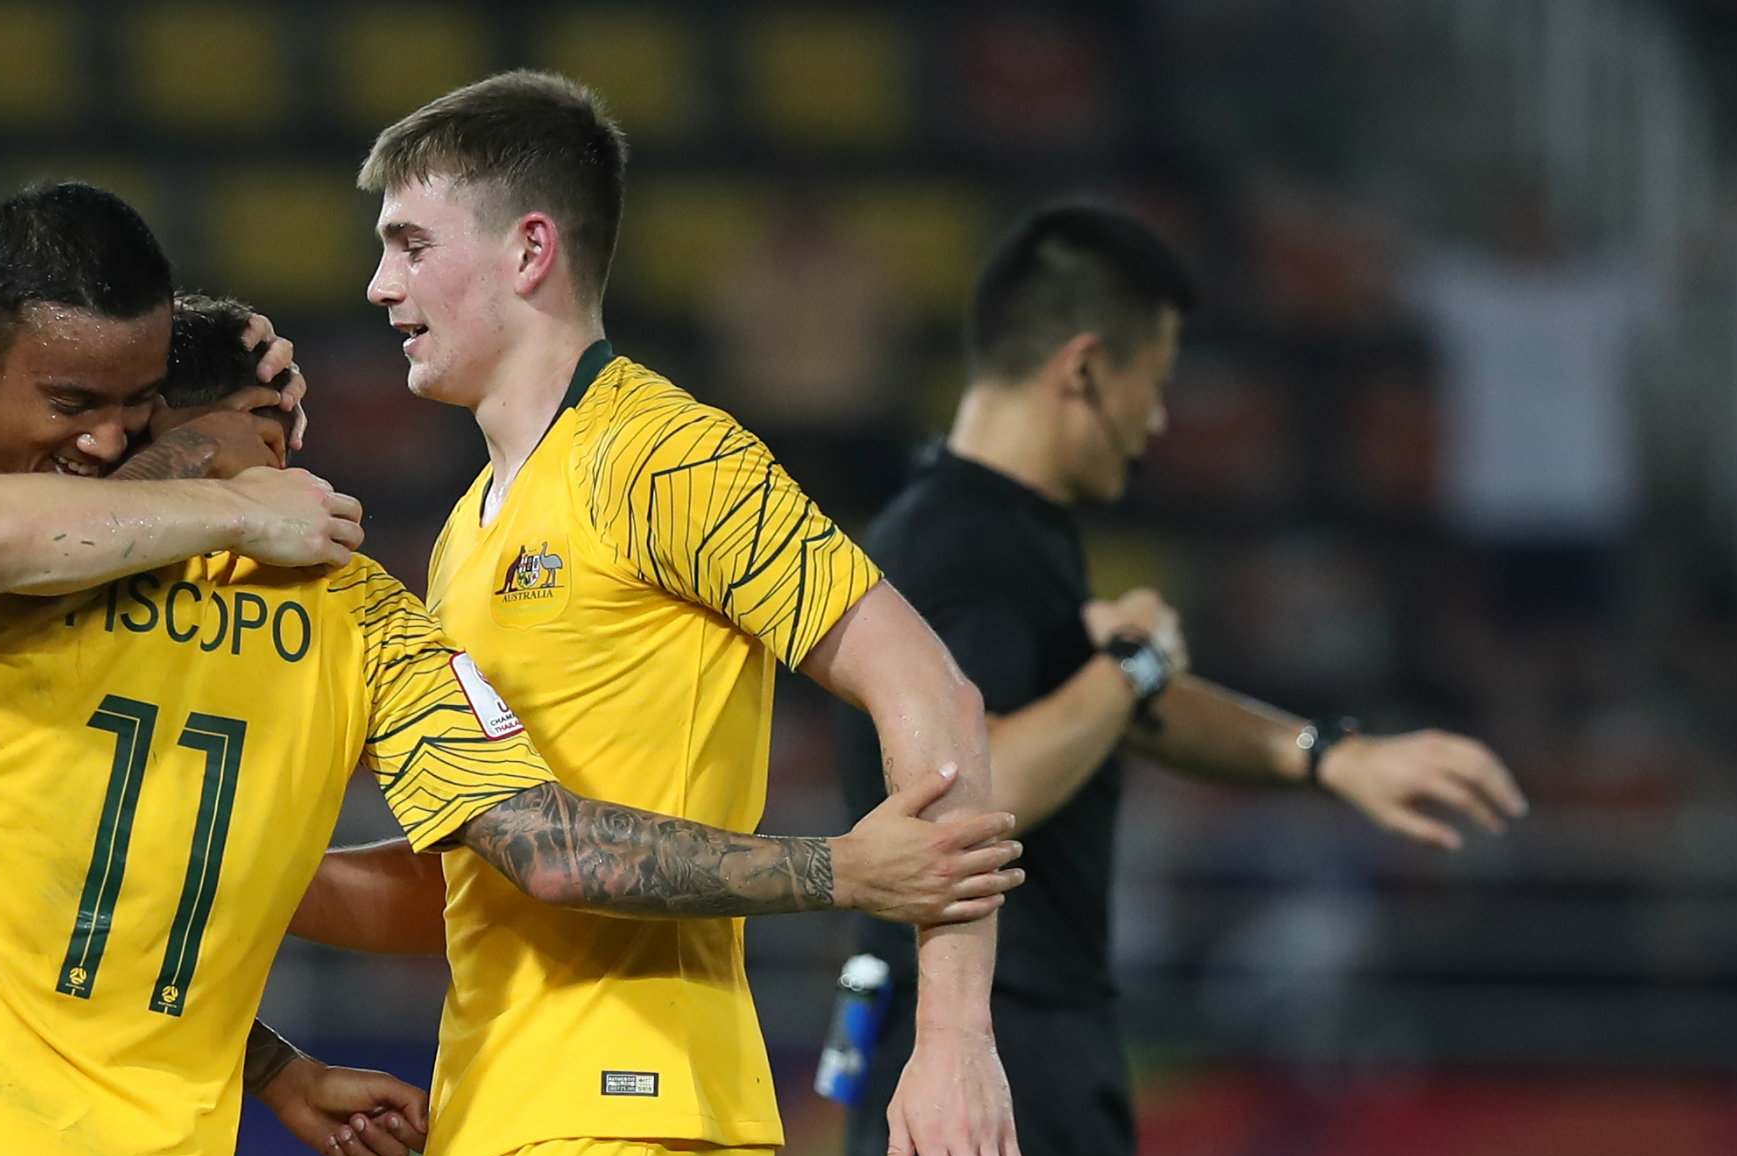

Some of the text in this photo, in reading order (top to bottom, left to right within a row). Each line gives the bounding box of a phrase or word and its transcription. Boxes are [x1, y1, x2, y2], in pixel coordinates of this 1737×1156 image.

[65, 571, 311, 662] ISCOPO
[503, 590, 553, 602] AUSTRALIA
[55, 693, 248, 1017] 11
